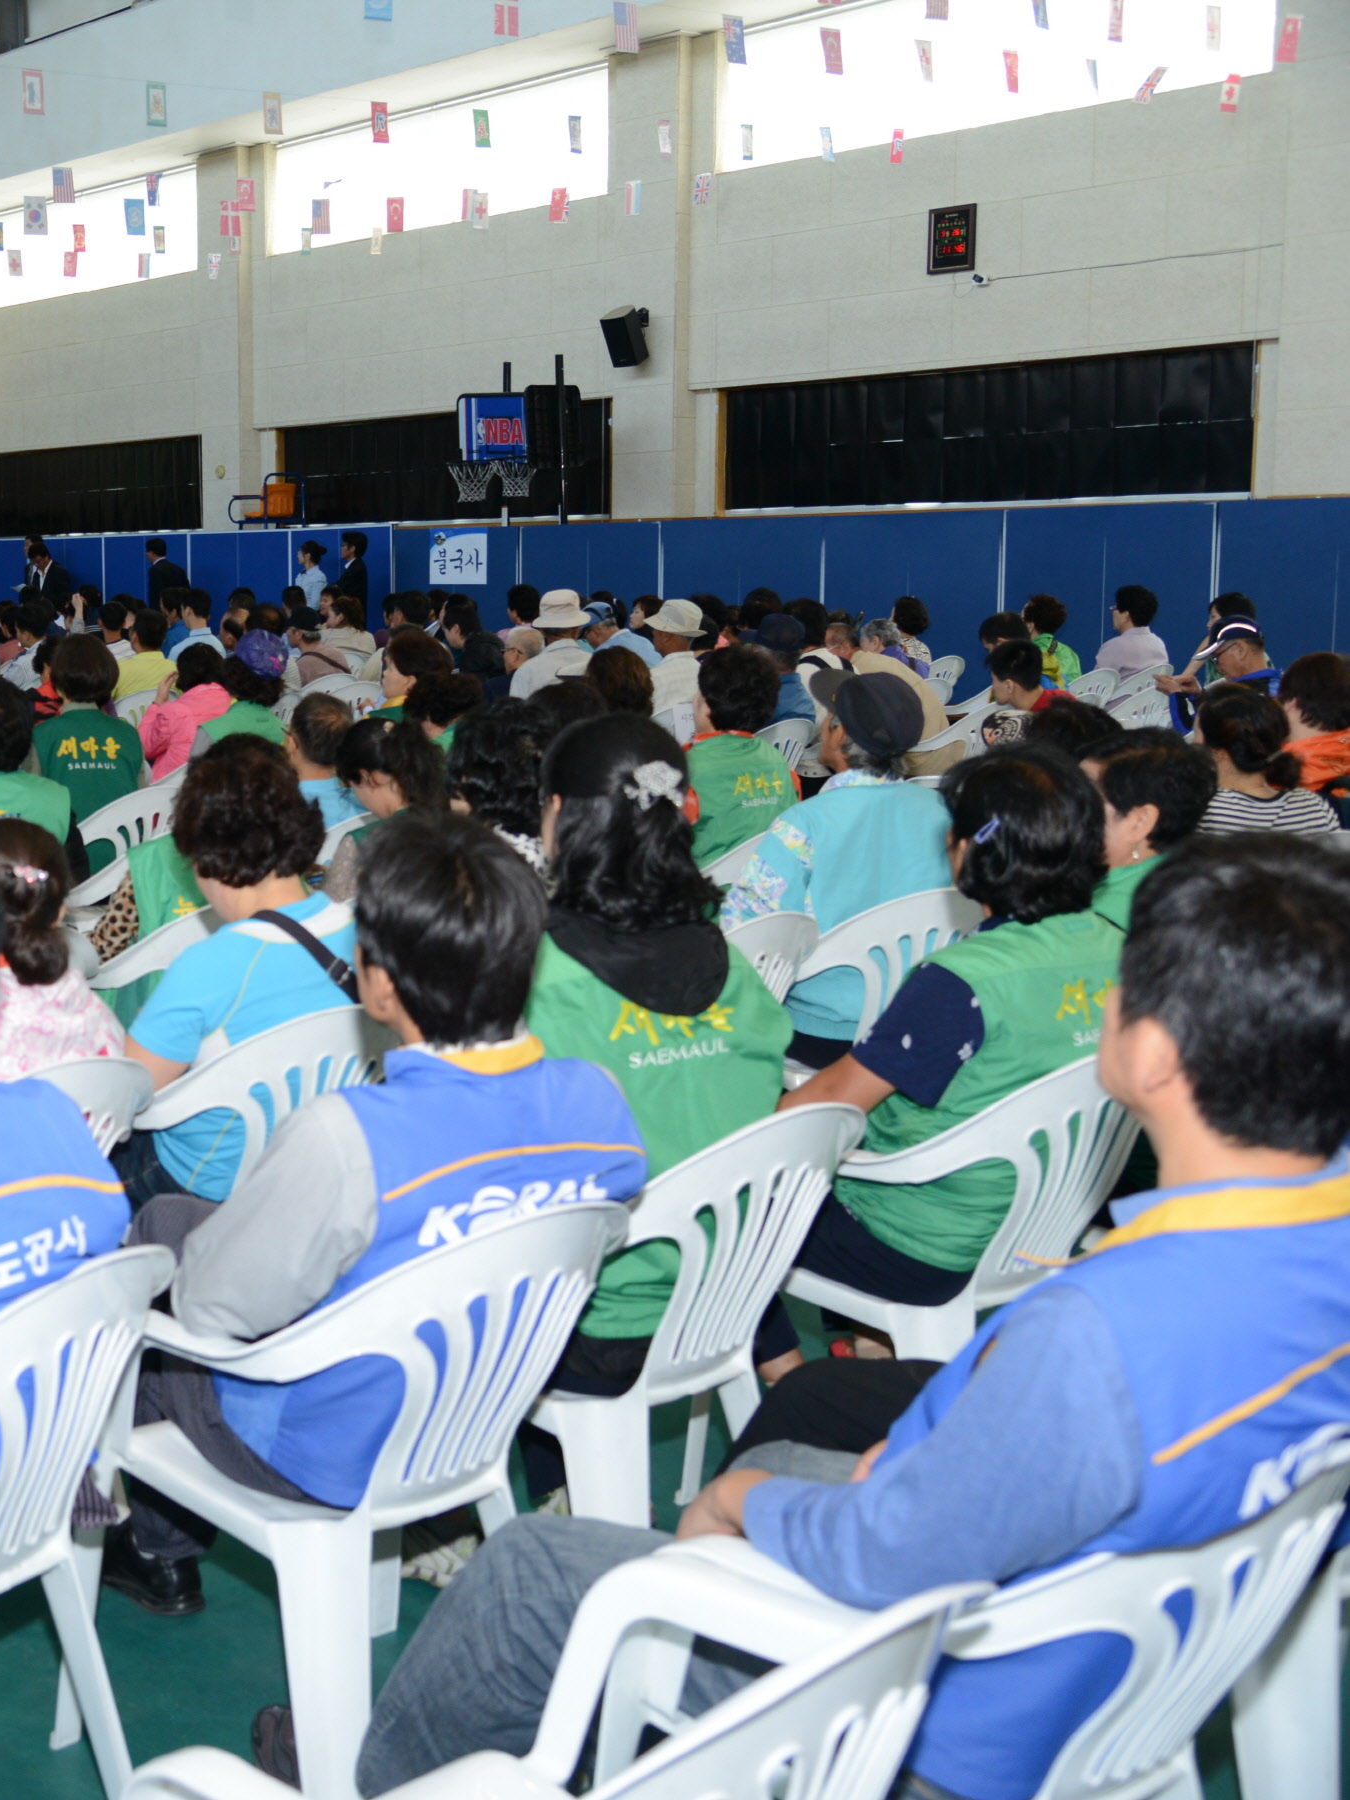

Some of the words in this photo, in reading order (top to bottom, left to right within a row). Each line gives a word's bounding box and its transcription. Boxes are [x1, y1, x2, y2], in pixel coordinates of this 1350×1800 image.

[485, 417, 525, 445] NBA
[433, 547, 484, 576] 불국사
[56, 735, 122, 760] 새마을
[67, 761, 117, 771] SAEMAUL
[734, 772, 783, 798] 새마을
[627, 1036, 730, 1070] SAEMAUL
